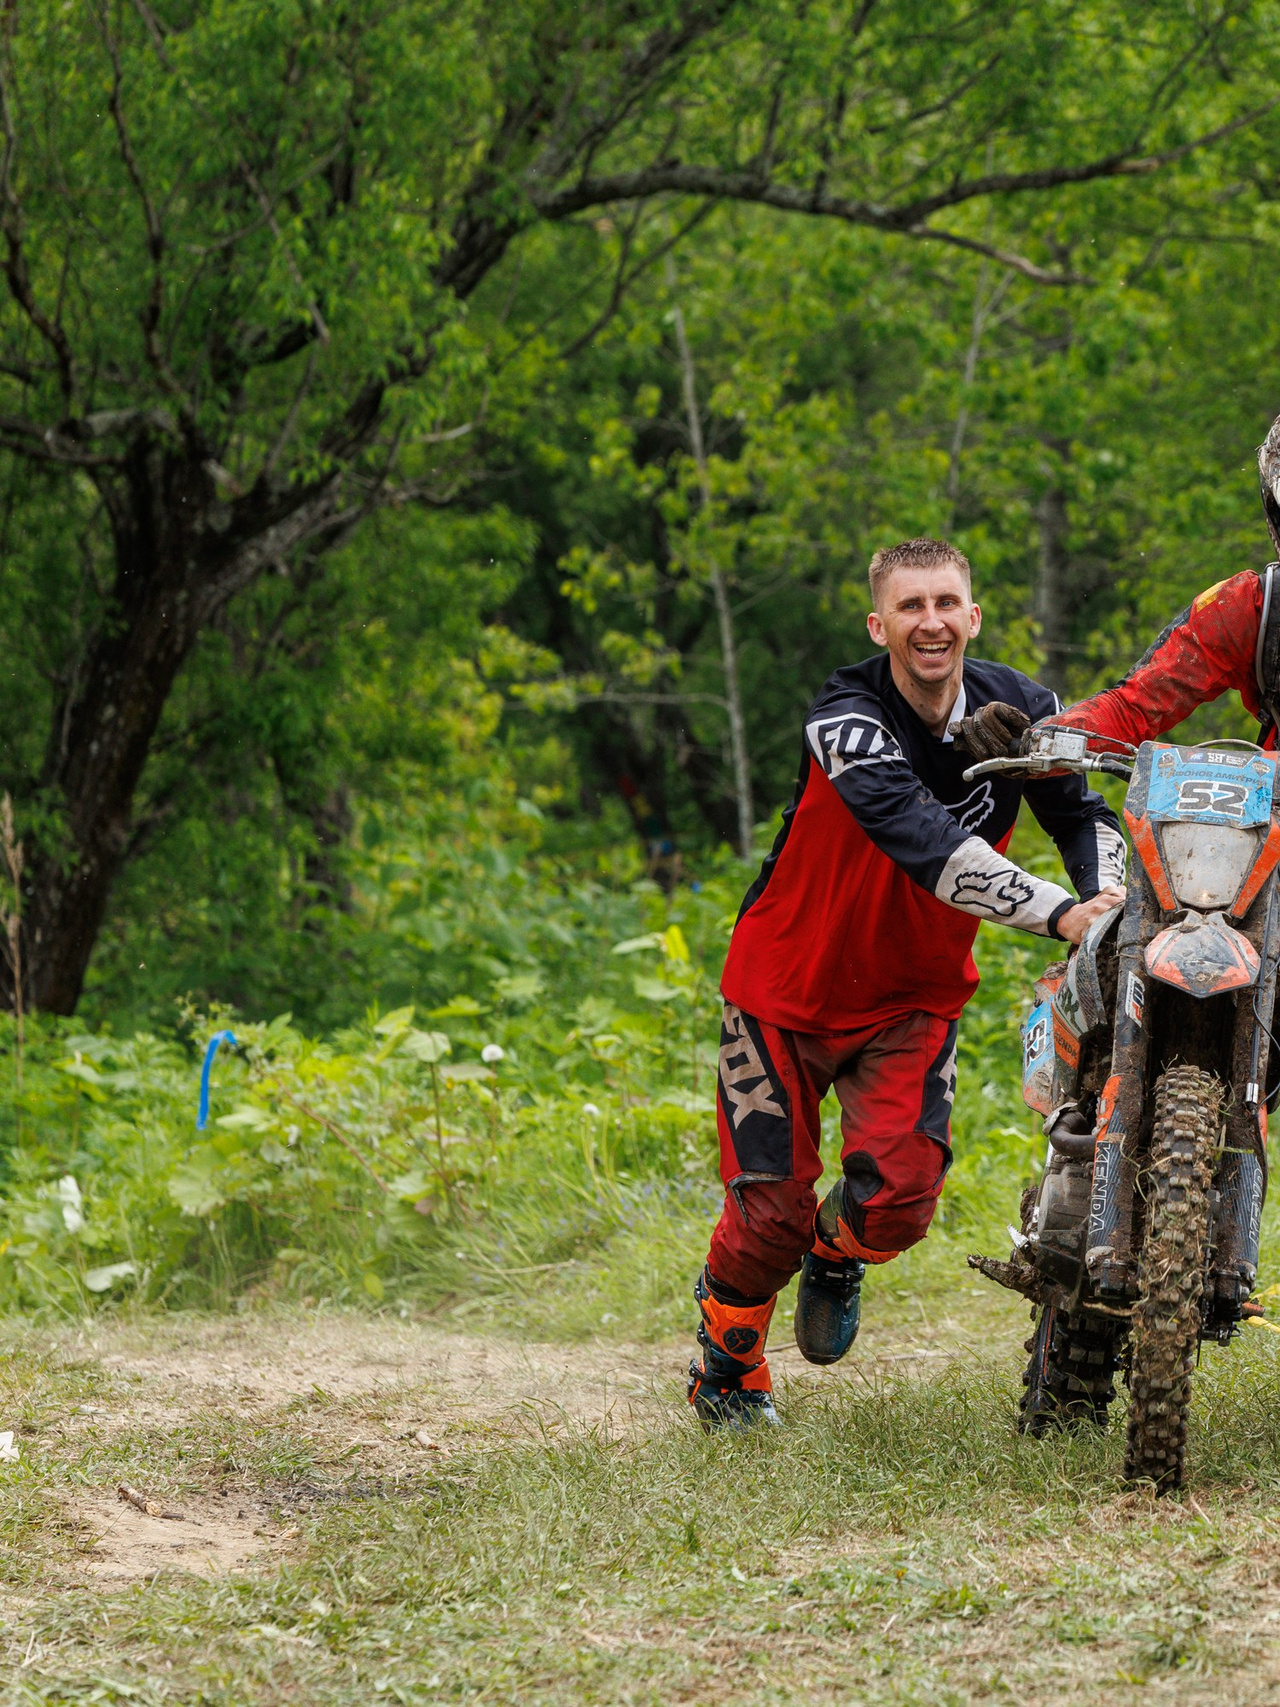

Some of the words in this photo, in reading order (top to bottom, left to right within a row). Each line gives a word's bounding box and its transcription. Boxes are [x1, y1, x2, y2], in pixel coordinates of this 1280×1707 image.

[1176, 780, 1249, 817] 52
[719, 1004, 787, 1130] FOX
[1025, 1017, 1047, 1071] 52
[1089, 1140, 1111, 1235] KENDA
